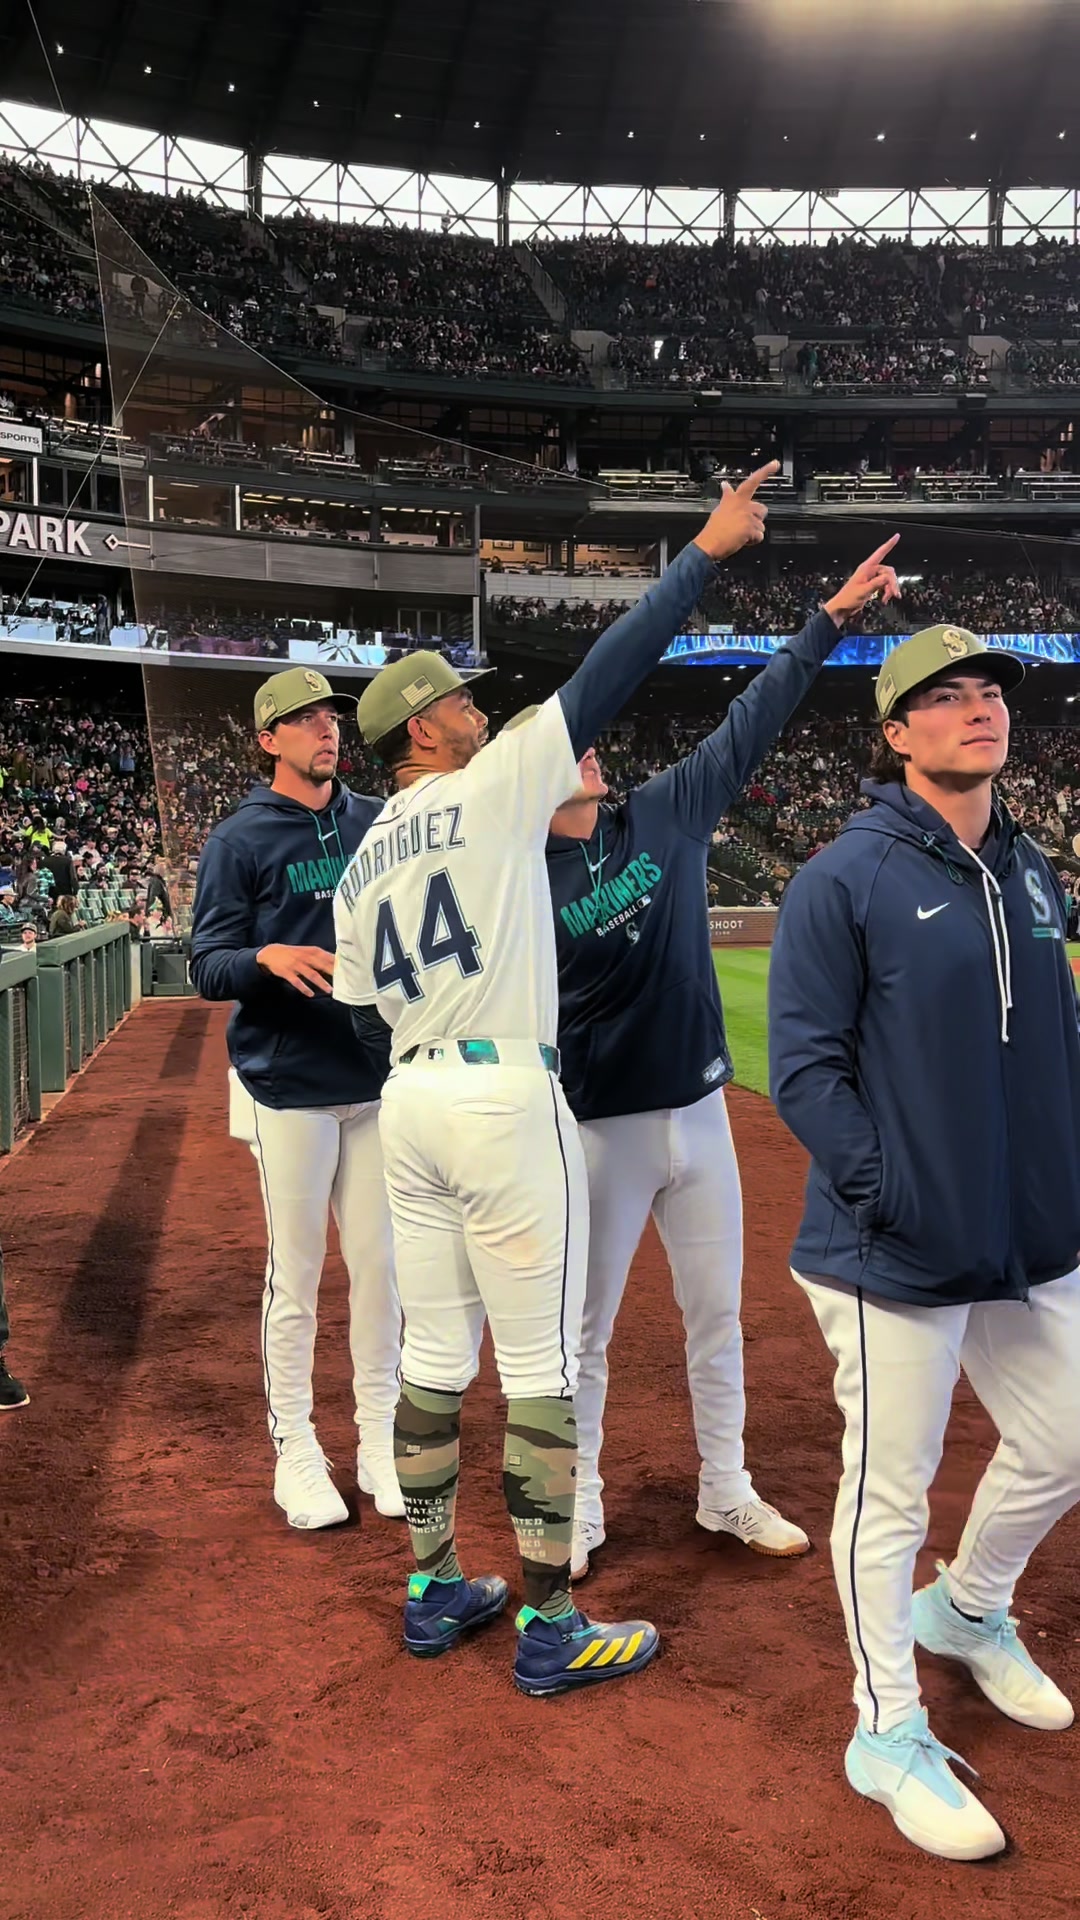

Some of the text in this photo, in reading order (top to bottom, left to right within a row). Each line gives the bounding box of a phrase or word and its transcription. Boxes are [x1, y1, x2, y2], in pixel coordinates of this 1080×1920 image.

[0, 431, 40, 445] SPORTS
[340, 803, 466, 914] RODRIGUEZ
[560, 852, 662, 938] MARINERS
[373, 866, 485, 1004] 44
[596, 904, 639, 937] BASEBALL
[403, 1497, 442, 1505] NITED
[406, 1506, 444, 1514] TATES
